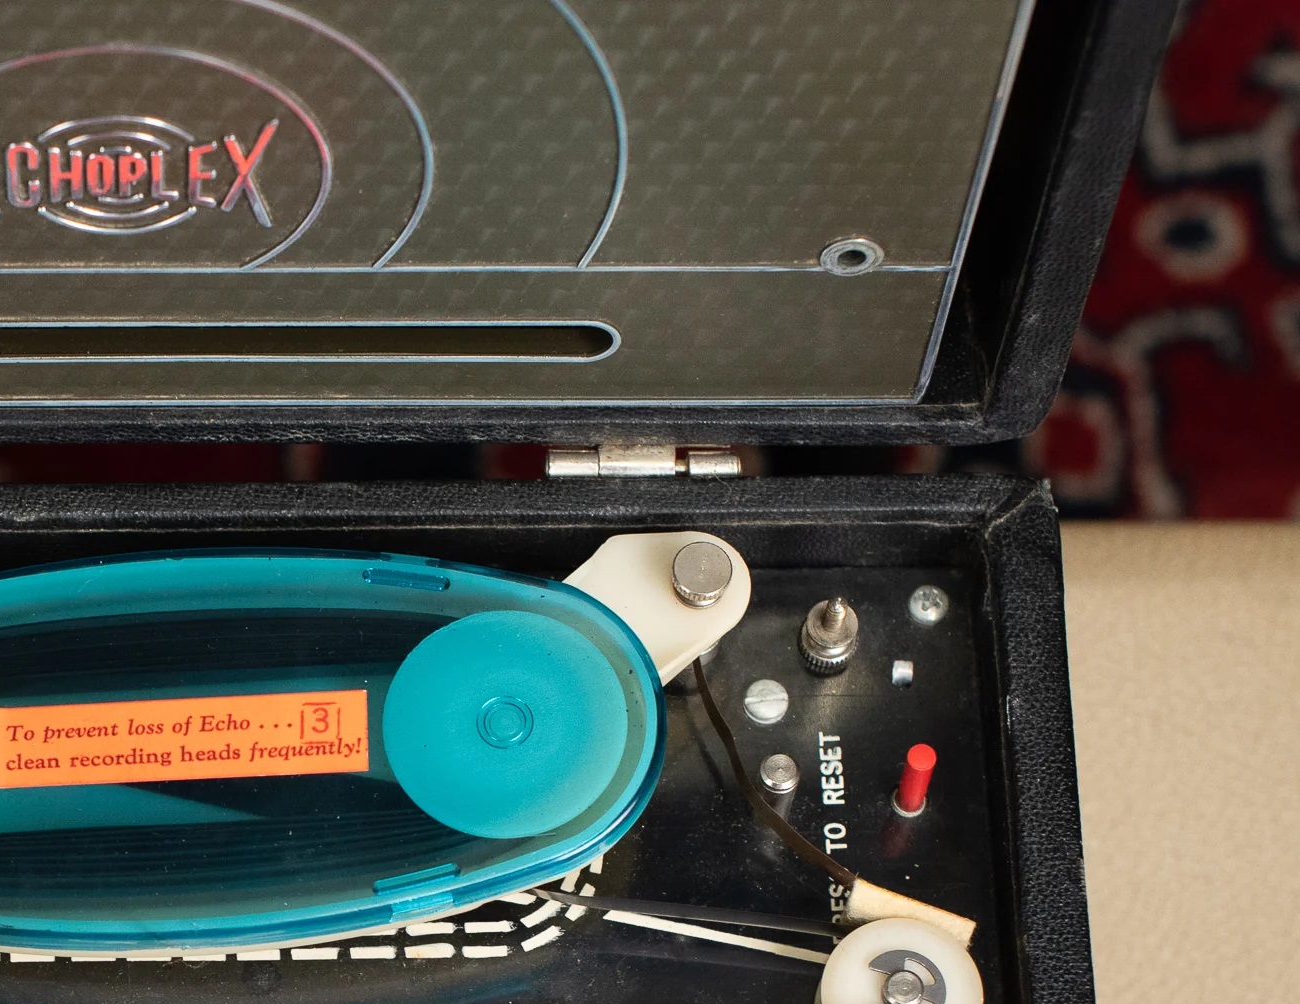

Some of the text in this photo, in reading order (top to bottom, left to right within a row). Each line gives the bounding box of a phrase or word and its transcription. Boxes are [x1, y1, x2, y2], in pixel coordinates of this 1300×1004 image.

[7, 725, 35, 742] To
[44, 719, 118, 742] prevent
[127, 716, 164, 736] loss
[172, 715, 193, 736] of
[199, 715, 251, 733] Echo
[6, 737, 362, 772] clean recording heads frequently!
[818, 731, 845, 806] RESET
[823, 822, 849, 855] TO
